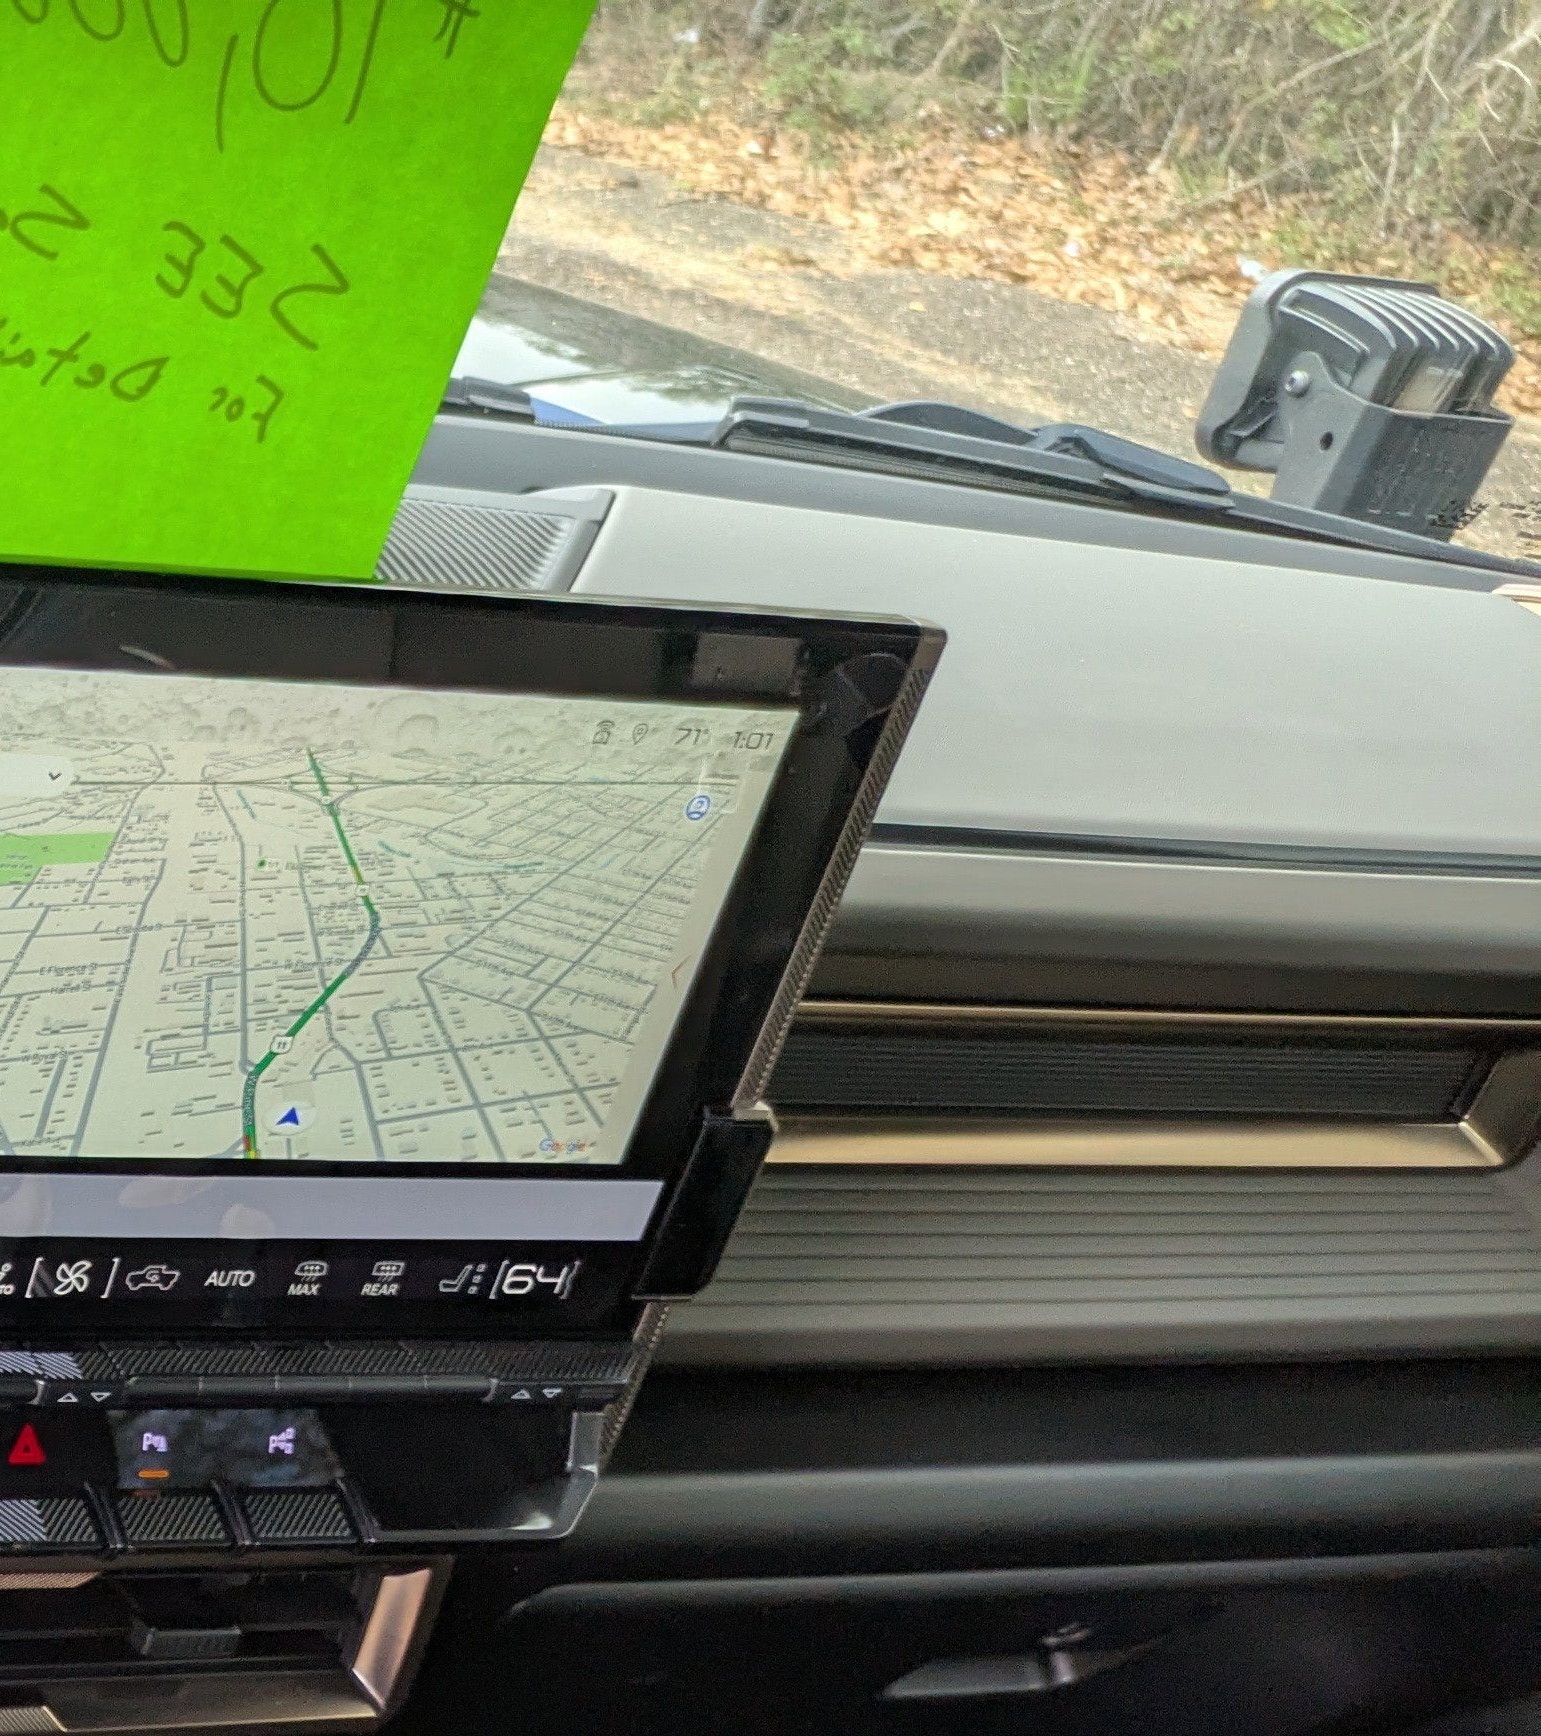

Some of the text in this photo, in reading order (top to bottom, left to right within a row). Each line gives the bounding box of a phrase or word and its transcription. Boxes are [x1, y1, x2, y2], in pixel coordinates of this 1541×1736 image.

[732, 731, 774, 750] 1:01
[205, 1269, 255, 1287] AUTO
[502, 1264, 568, 1295] 64
[287, 1283, 322, 1296] MAX
[362, 1283, 399, 1296] REAR
